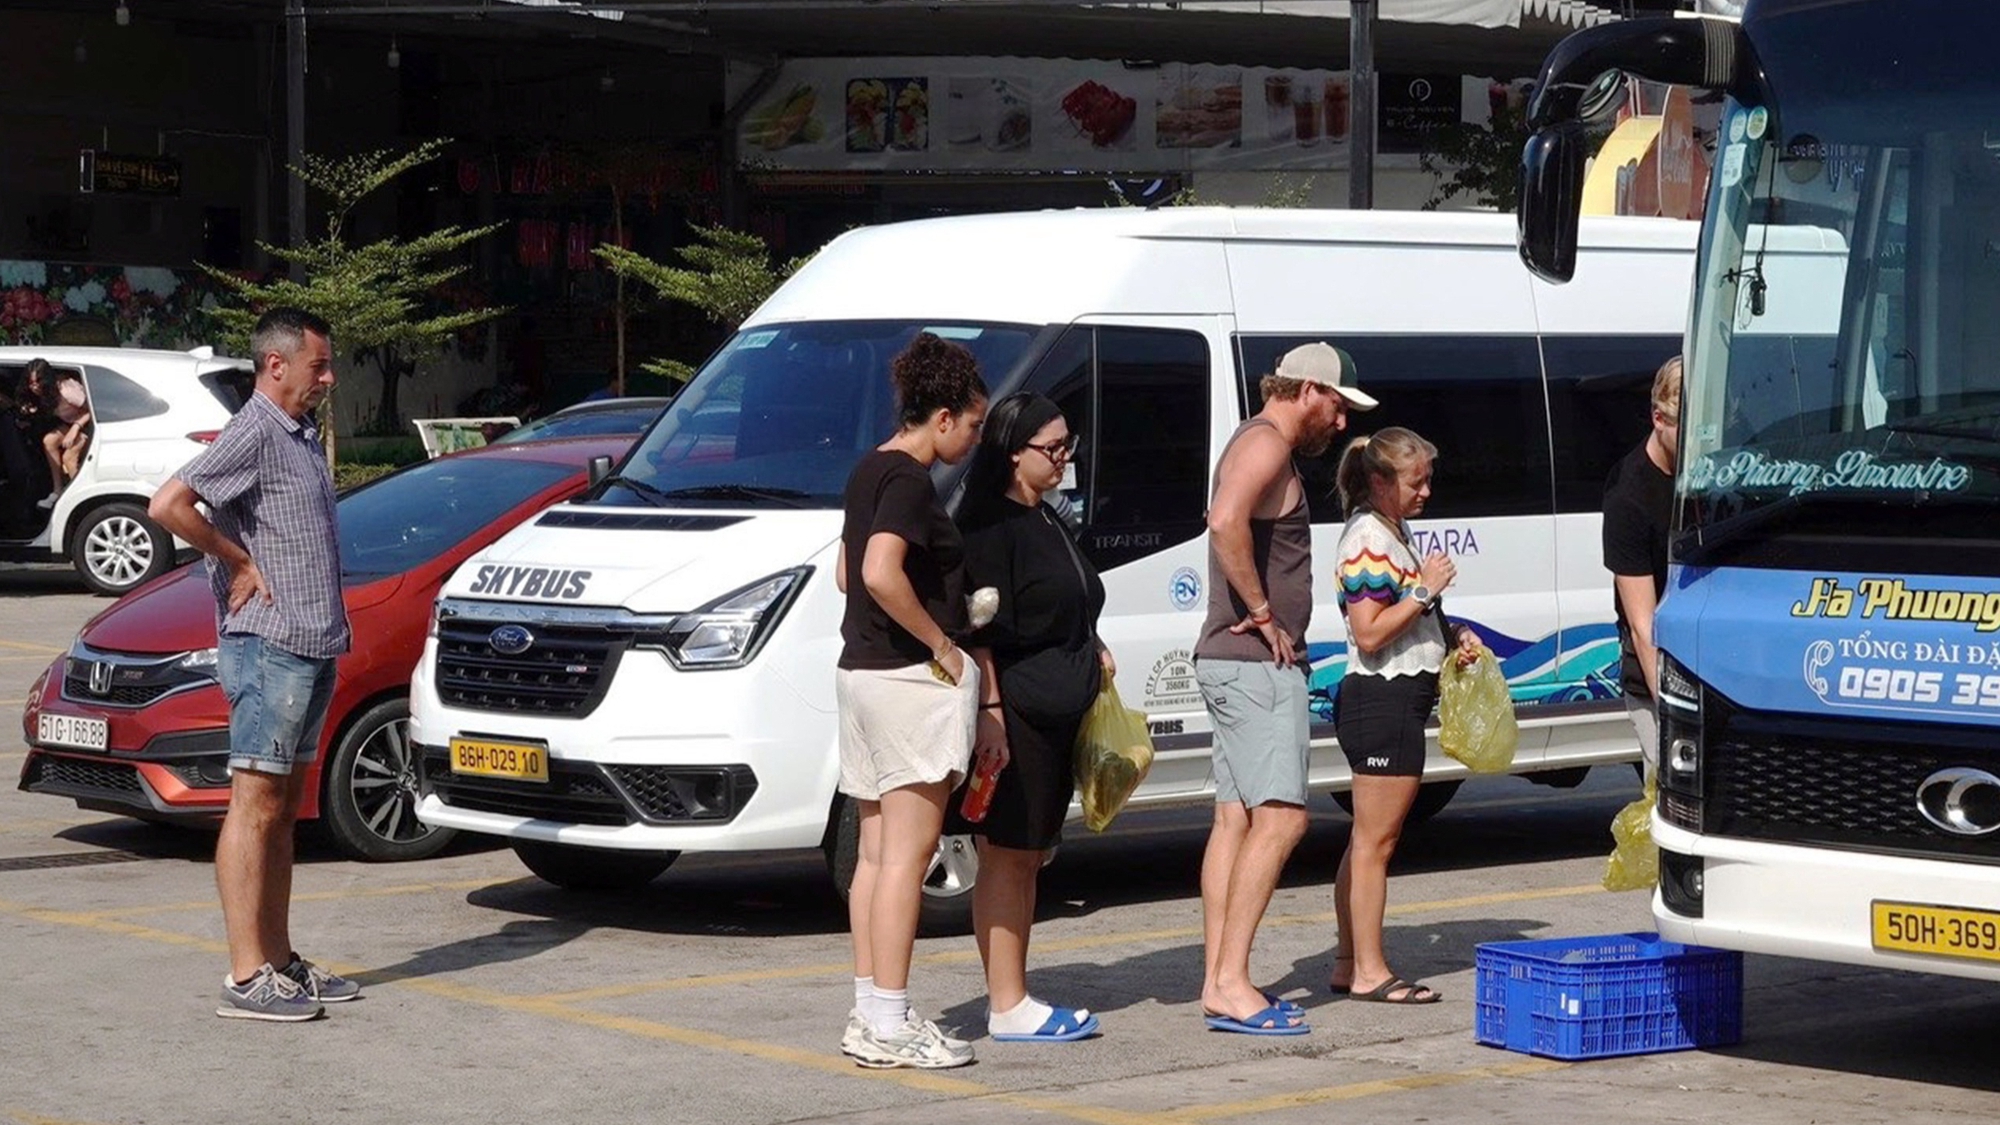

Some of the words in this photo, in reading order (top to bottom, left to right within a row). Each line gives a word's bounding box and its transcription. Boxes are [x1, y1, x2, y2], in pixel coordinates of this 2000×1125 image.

[1823, 451, 1969, 491] Limousine
[1093, 533, 1163, 549] TRANSIT
[1412, 528, 1480, 556] TARA
[469, 565, 592, 599] SKYBUS
[1838, 630, 1908, 661] TỔNG
[1914, 637, 1960, 664] ĐÀI
[1966, 641, 2000, 670] ĐẶ
[1838, 666, 1943, 703] 0905
[1951, 673, 2000, 707] 39
[40, 715, 106, 747] 51G-166.88
[1146, 719, 1184, 735] YBUS
[459, 745, 539, 774] 86H-029.10
[1366, 756, 1390, 767] RW
